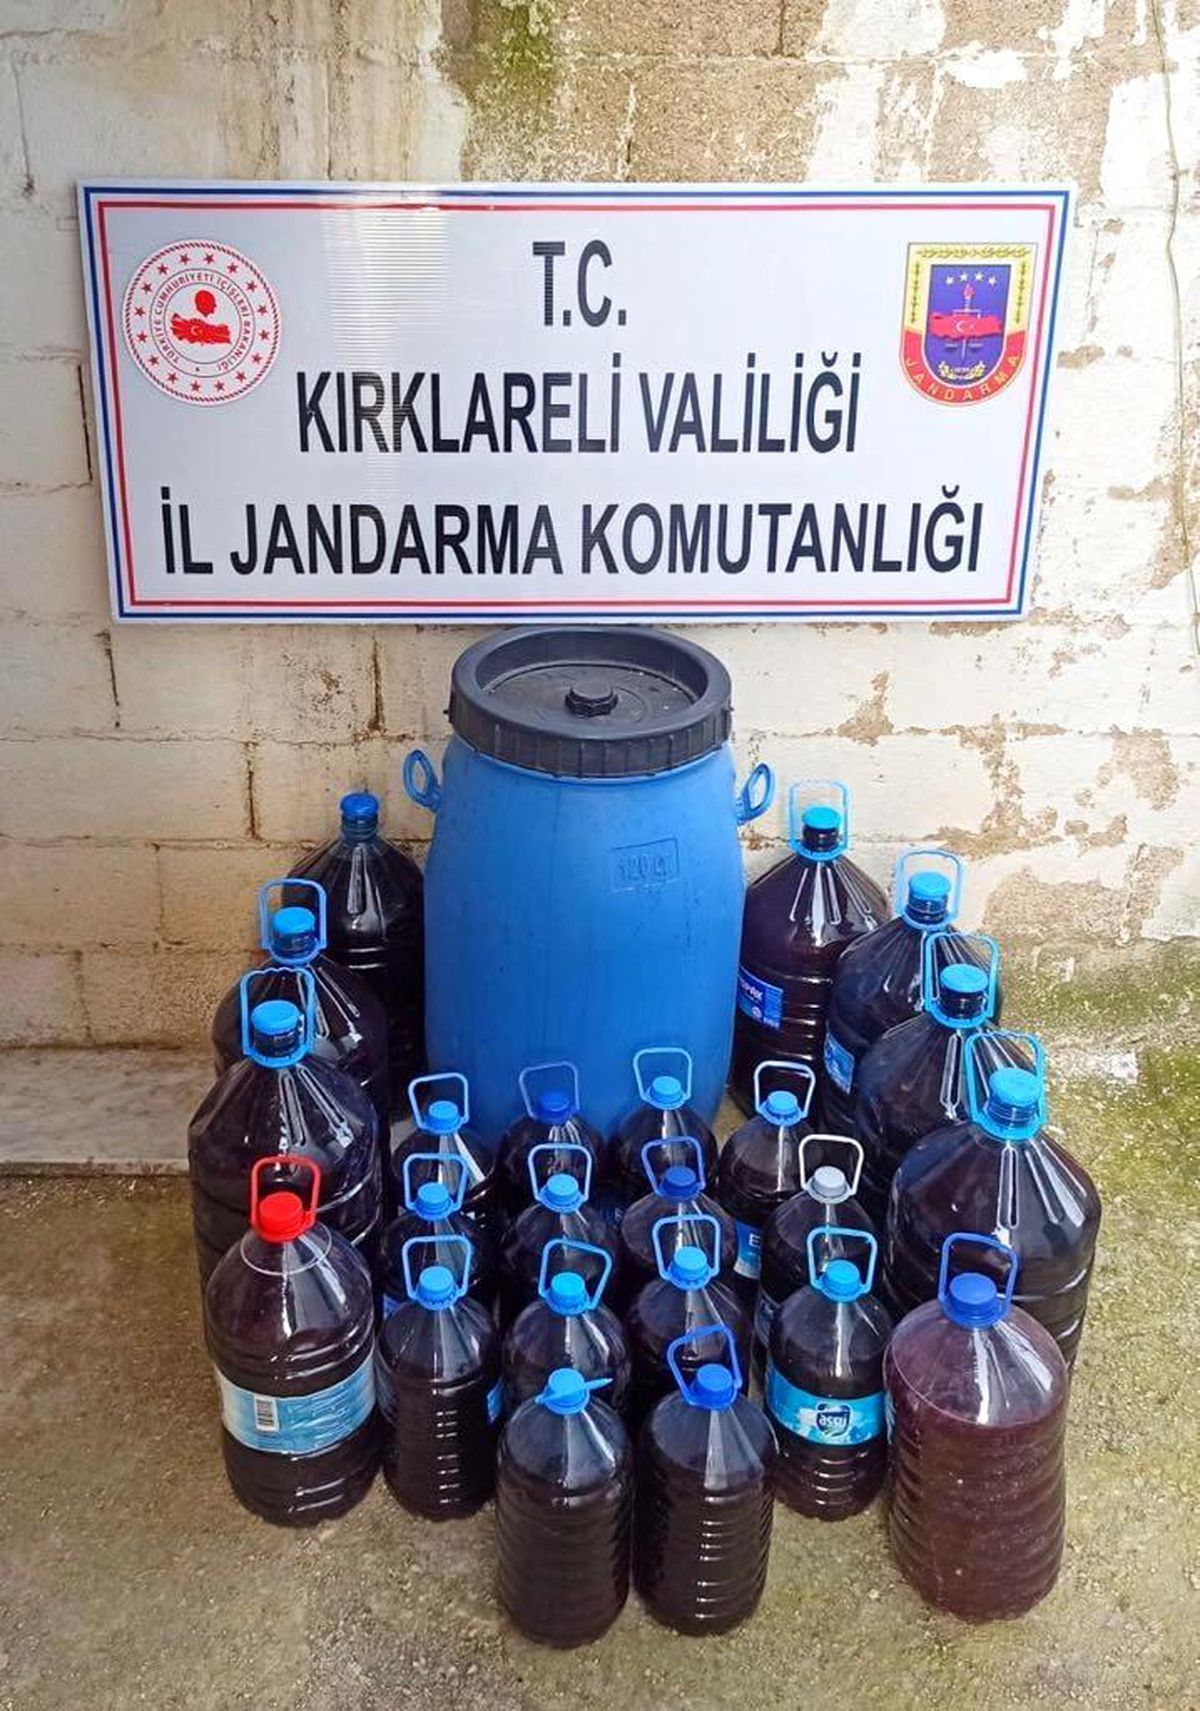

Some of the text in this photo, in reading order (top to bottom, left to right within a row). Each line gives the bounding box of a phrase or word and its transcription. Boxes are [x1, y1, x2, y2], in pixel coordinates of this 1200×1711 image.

[532, 240, 626, 327] T.C.
[296, 351, 861, 454] KIRKLARELİ VALİLİĞİ
[905, 354, 1020, 401] JANDARMA
[160, 485, 983, 576] İL JANDARMA KOMUTANLIĞI
